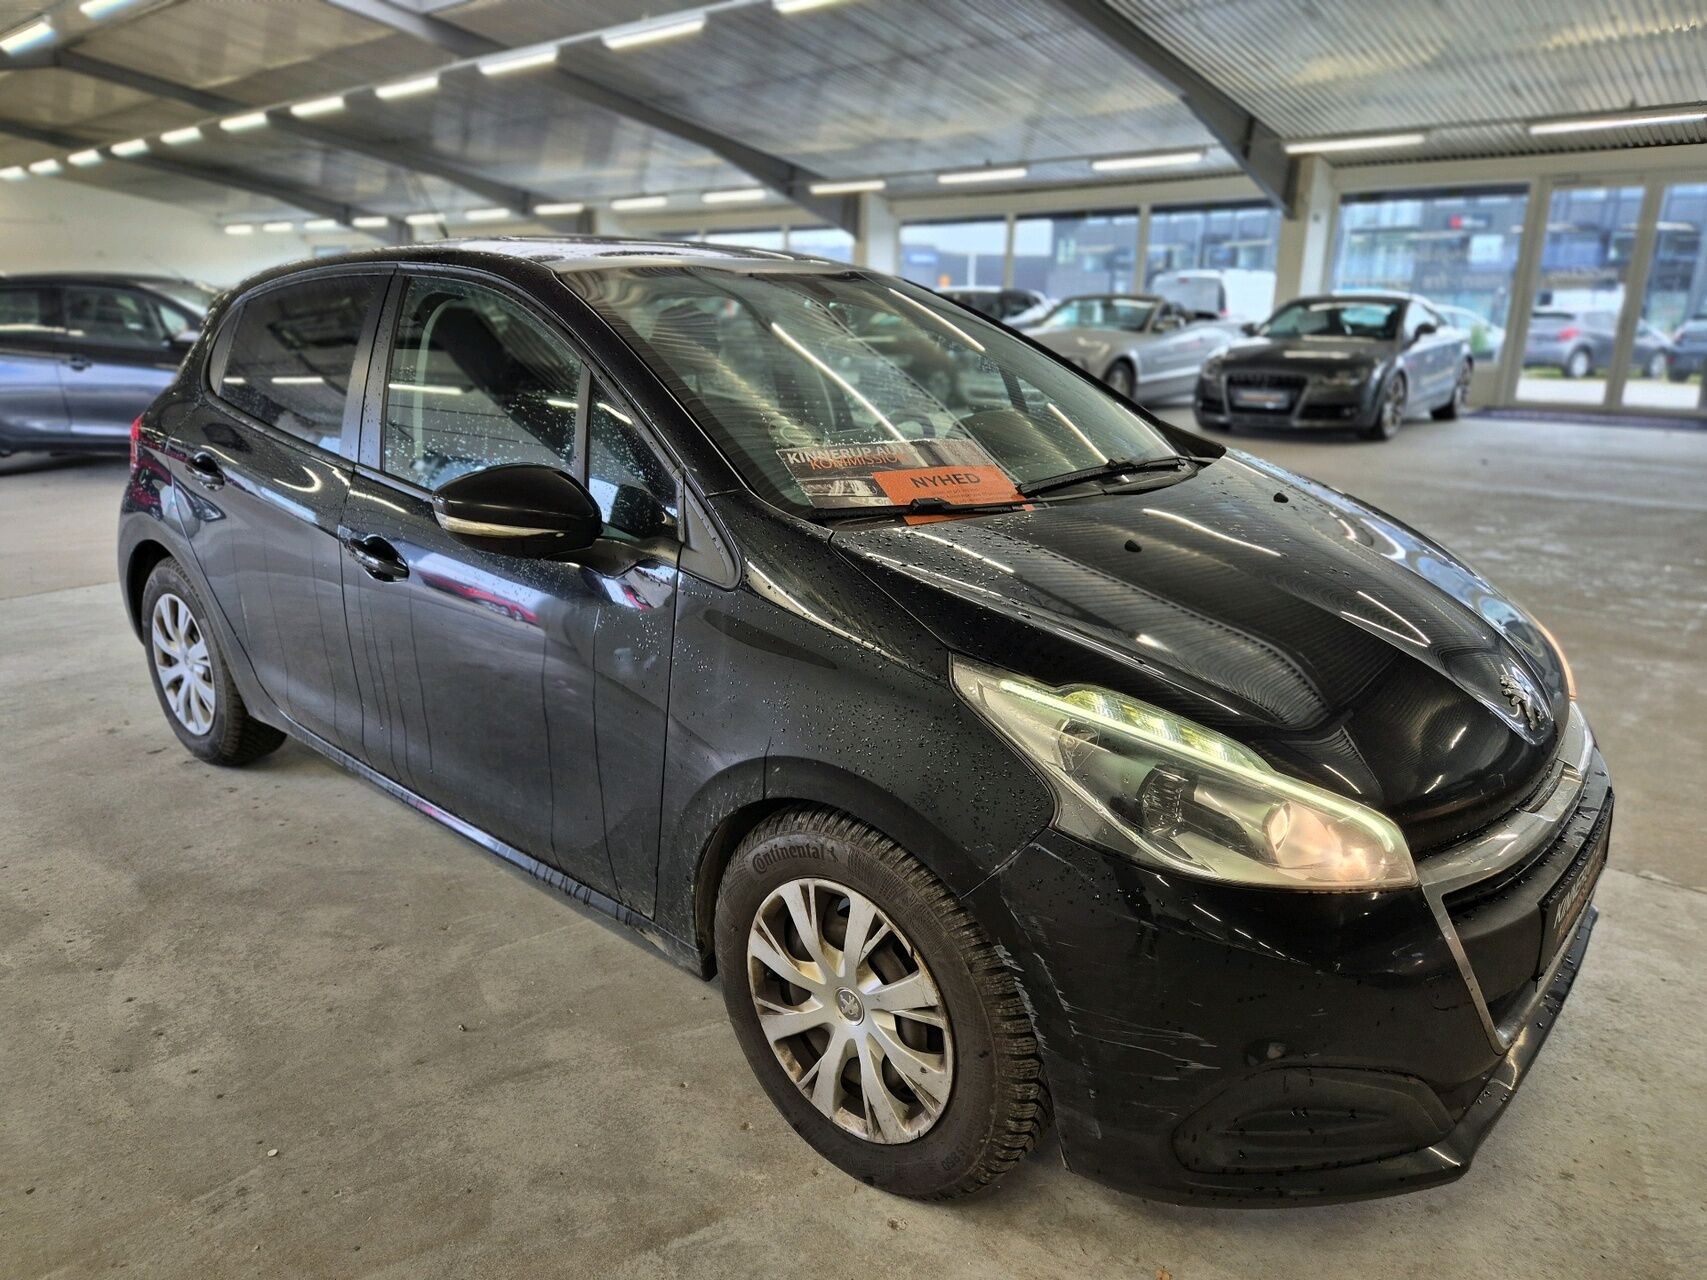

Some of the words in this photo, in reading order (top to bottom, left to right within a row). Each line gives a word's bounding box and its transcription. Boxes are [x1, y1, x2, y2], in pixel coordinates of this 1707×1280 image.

[786, 445, 872, 464] KINNERUP
[909, 472, 981, 488] NYHED
[752, 843, 826, 875] Continental
